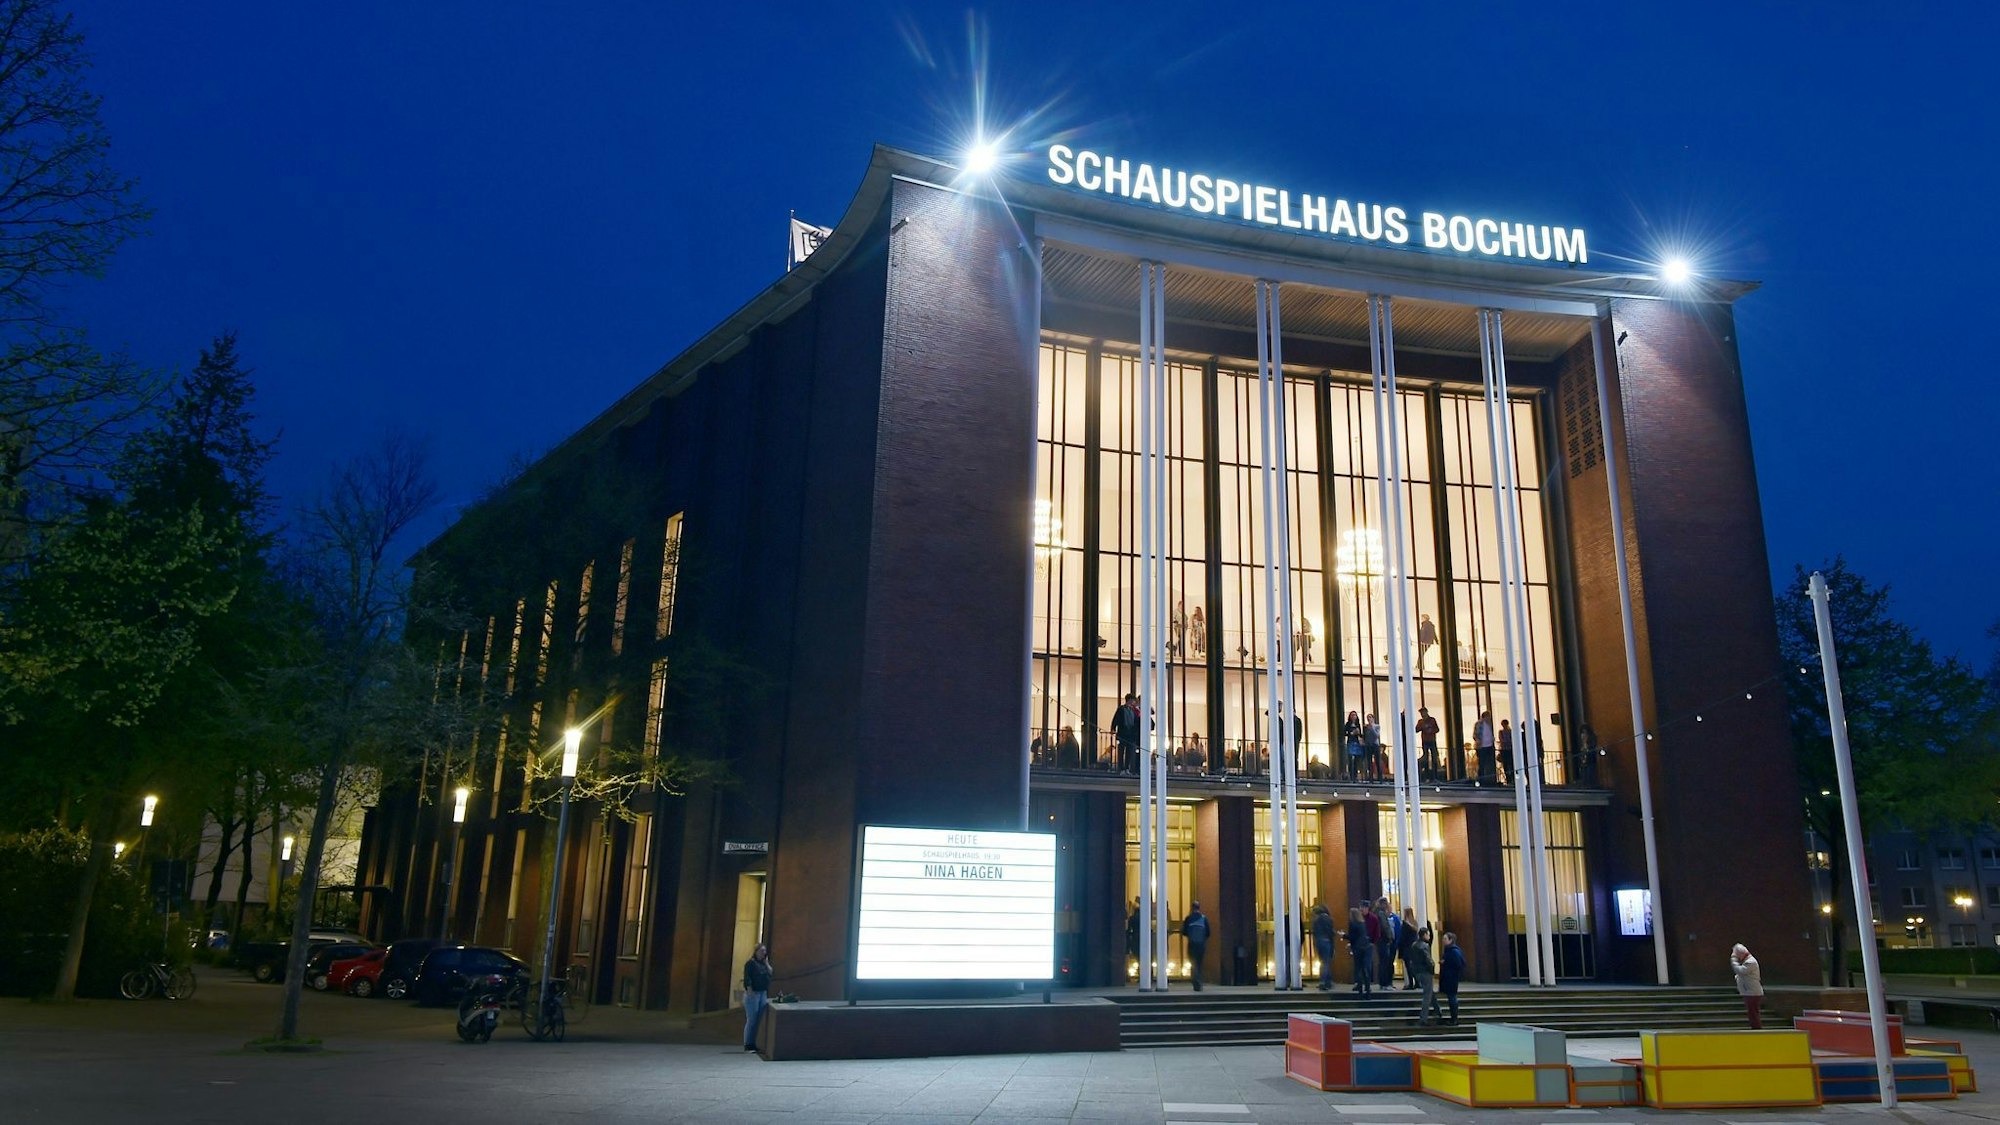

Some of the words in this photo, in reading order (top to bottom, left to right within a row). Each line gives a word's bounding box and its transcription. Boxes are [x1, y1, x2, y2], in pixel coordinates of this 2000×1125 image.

[1047, 143, 1410, 245] SCHAUSPIELHAUS
[1422, 211, 1588, 264] BOCHUM
[947, 834, 979, 845] HEUTE
[924, 864, 956, 878] NINA
[961, 865, 1003, 879] HAGEN
